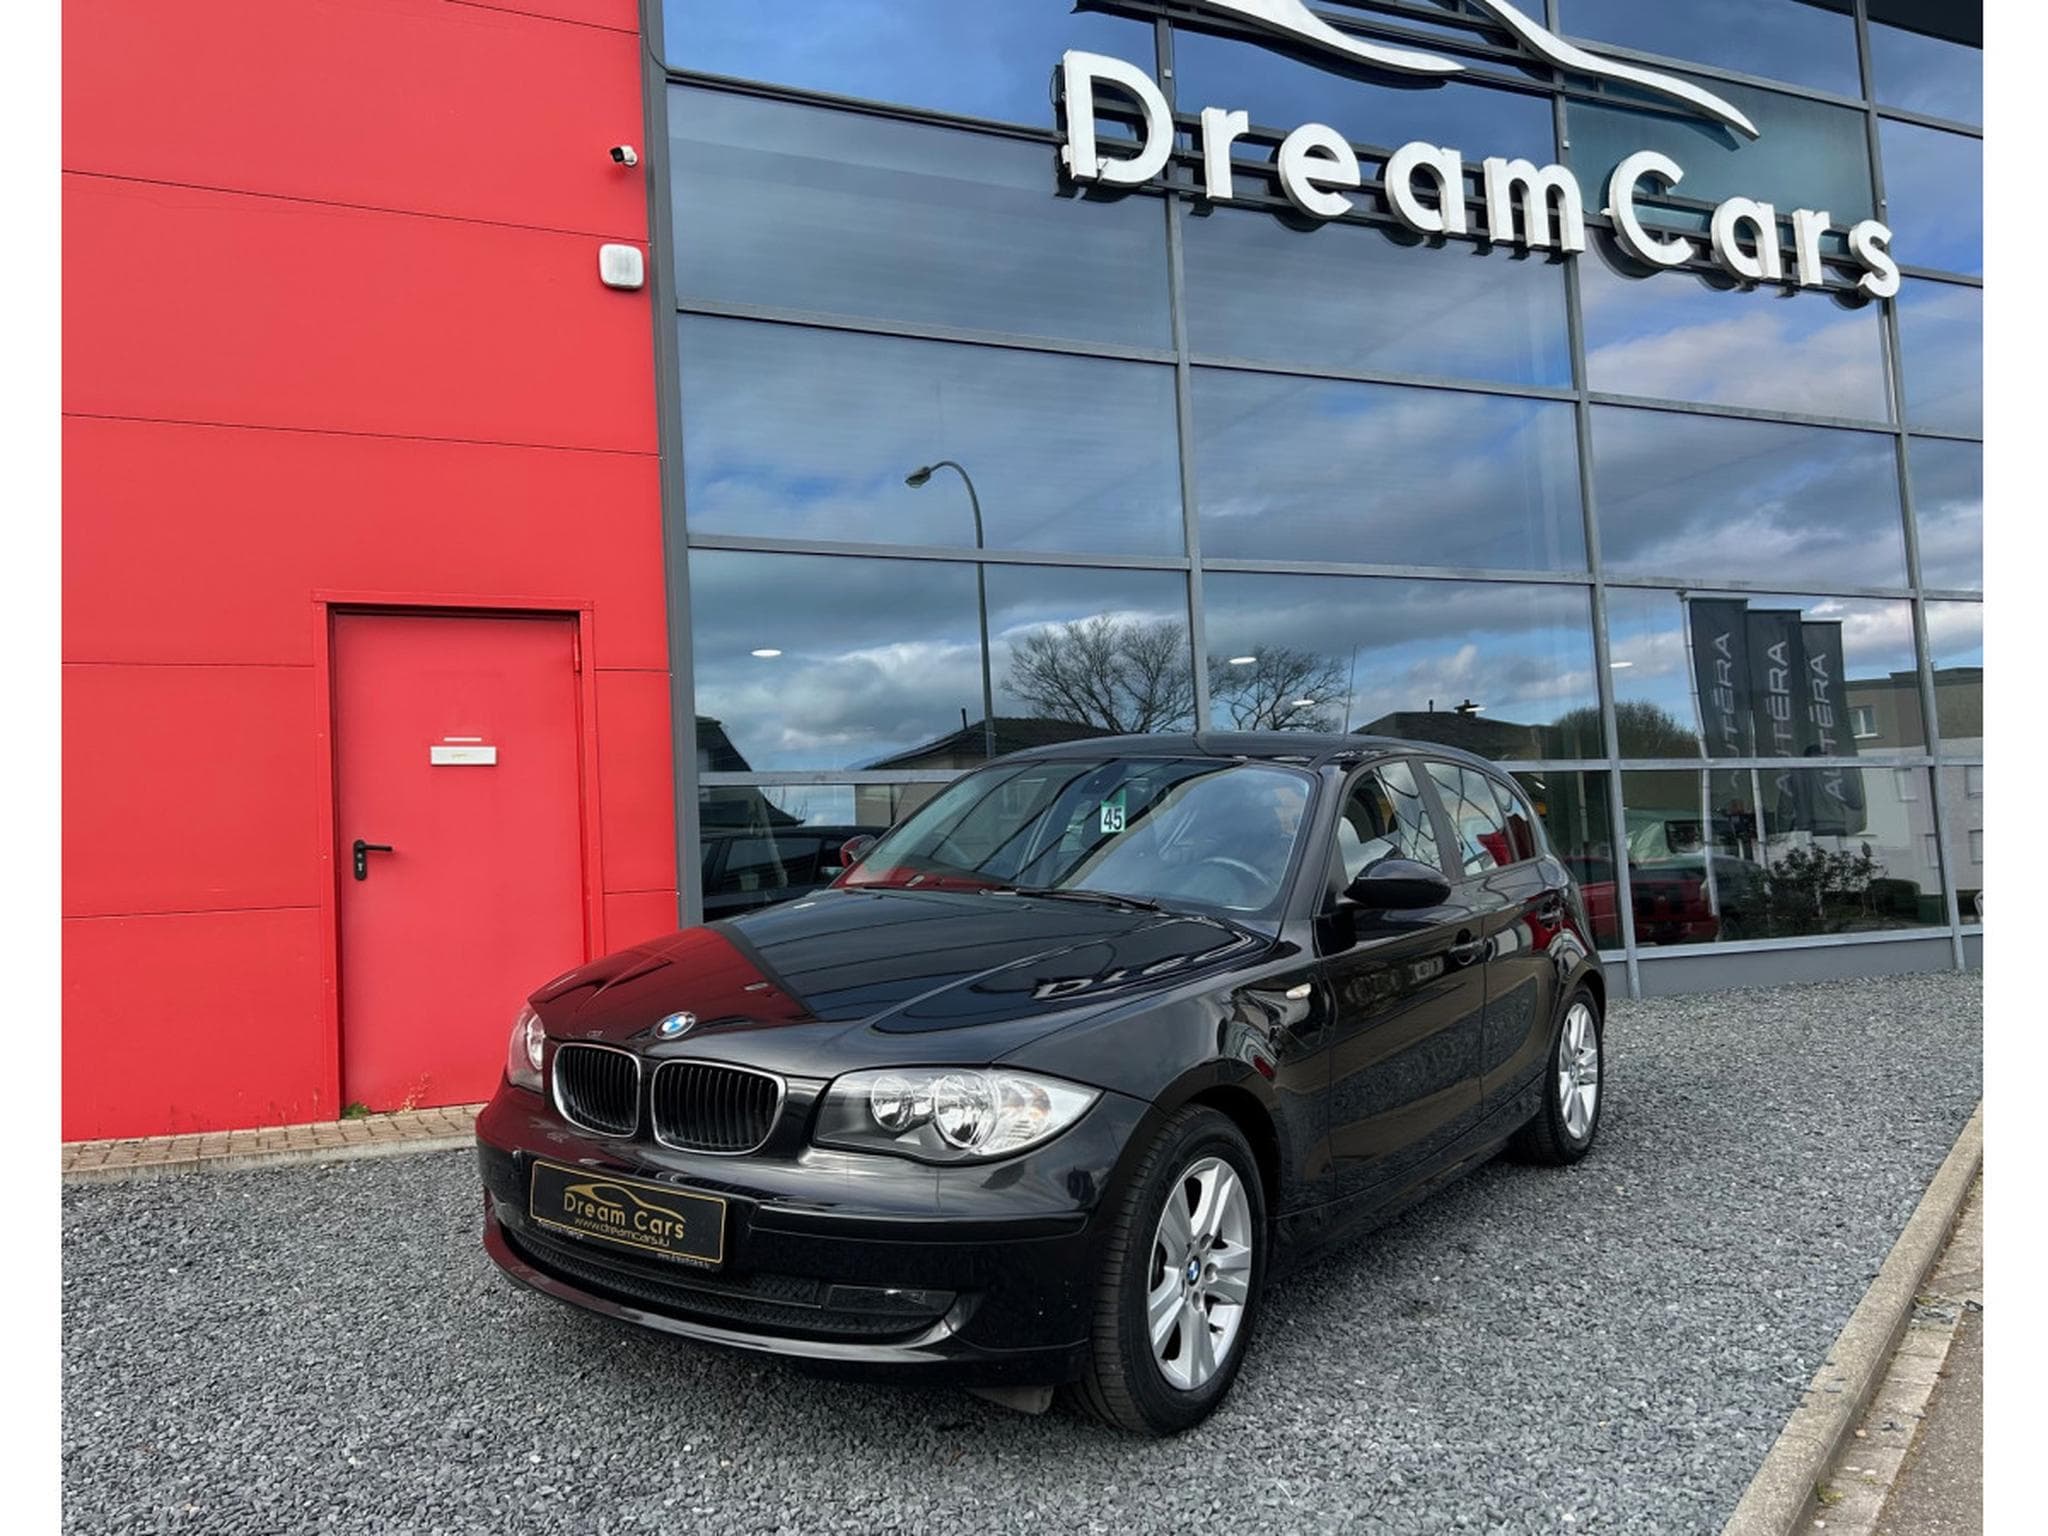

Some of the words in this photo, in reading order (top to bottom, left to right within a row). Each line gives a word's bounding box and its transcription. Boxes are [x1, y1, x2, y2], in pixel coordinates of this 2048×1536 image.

[1062, 50, 1585, 255] Dream
[1606, 151, 1900, 298] Cars
[1104, 808, 1122, 830] 45
[563, 1192, 626, 1226] Dream
[634, 1211, 685, 1239] Cars
